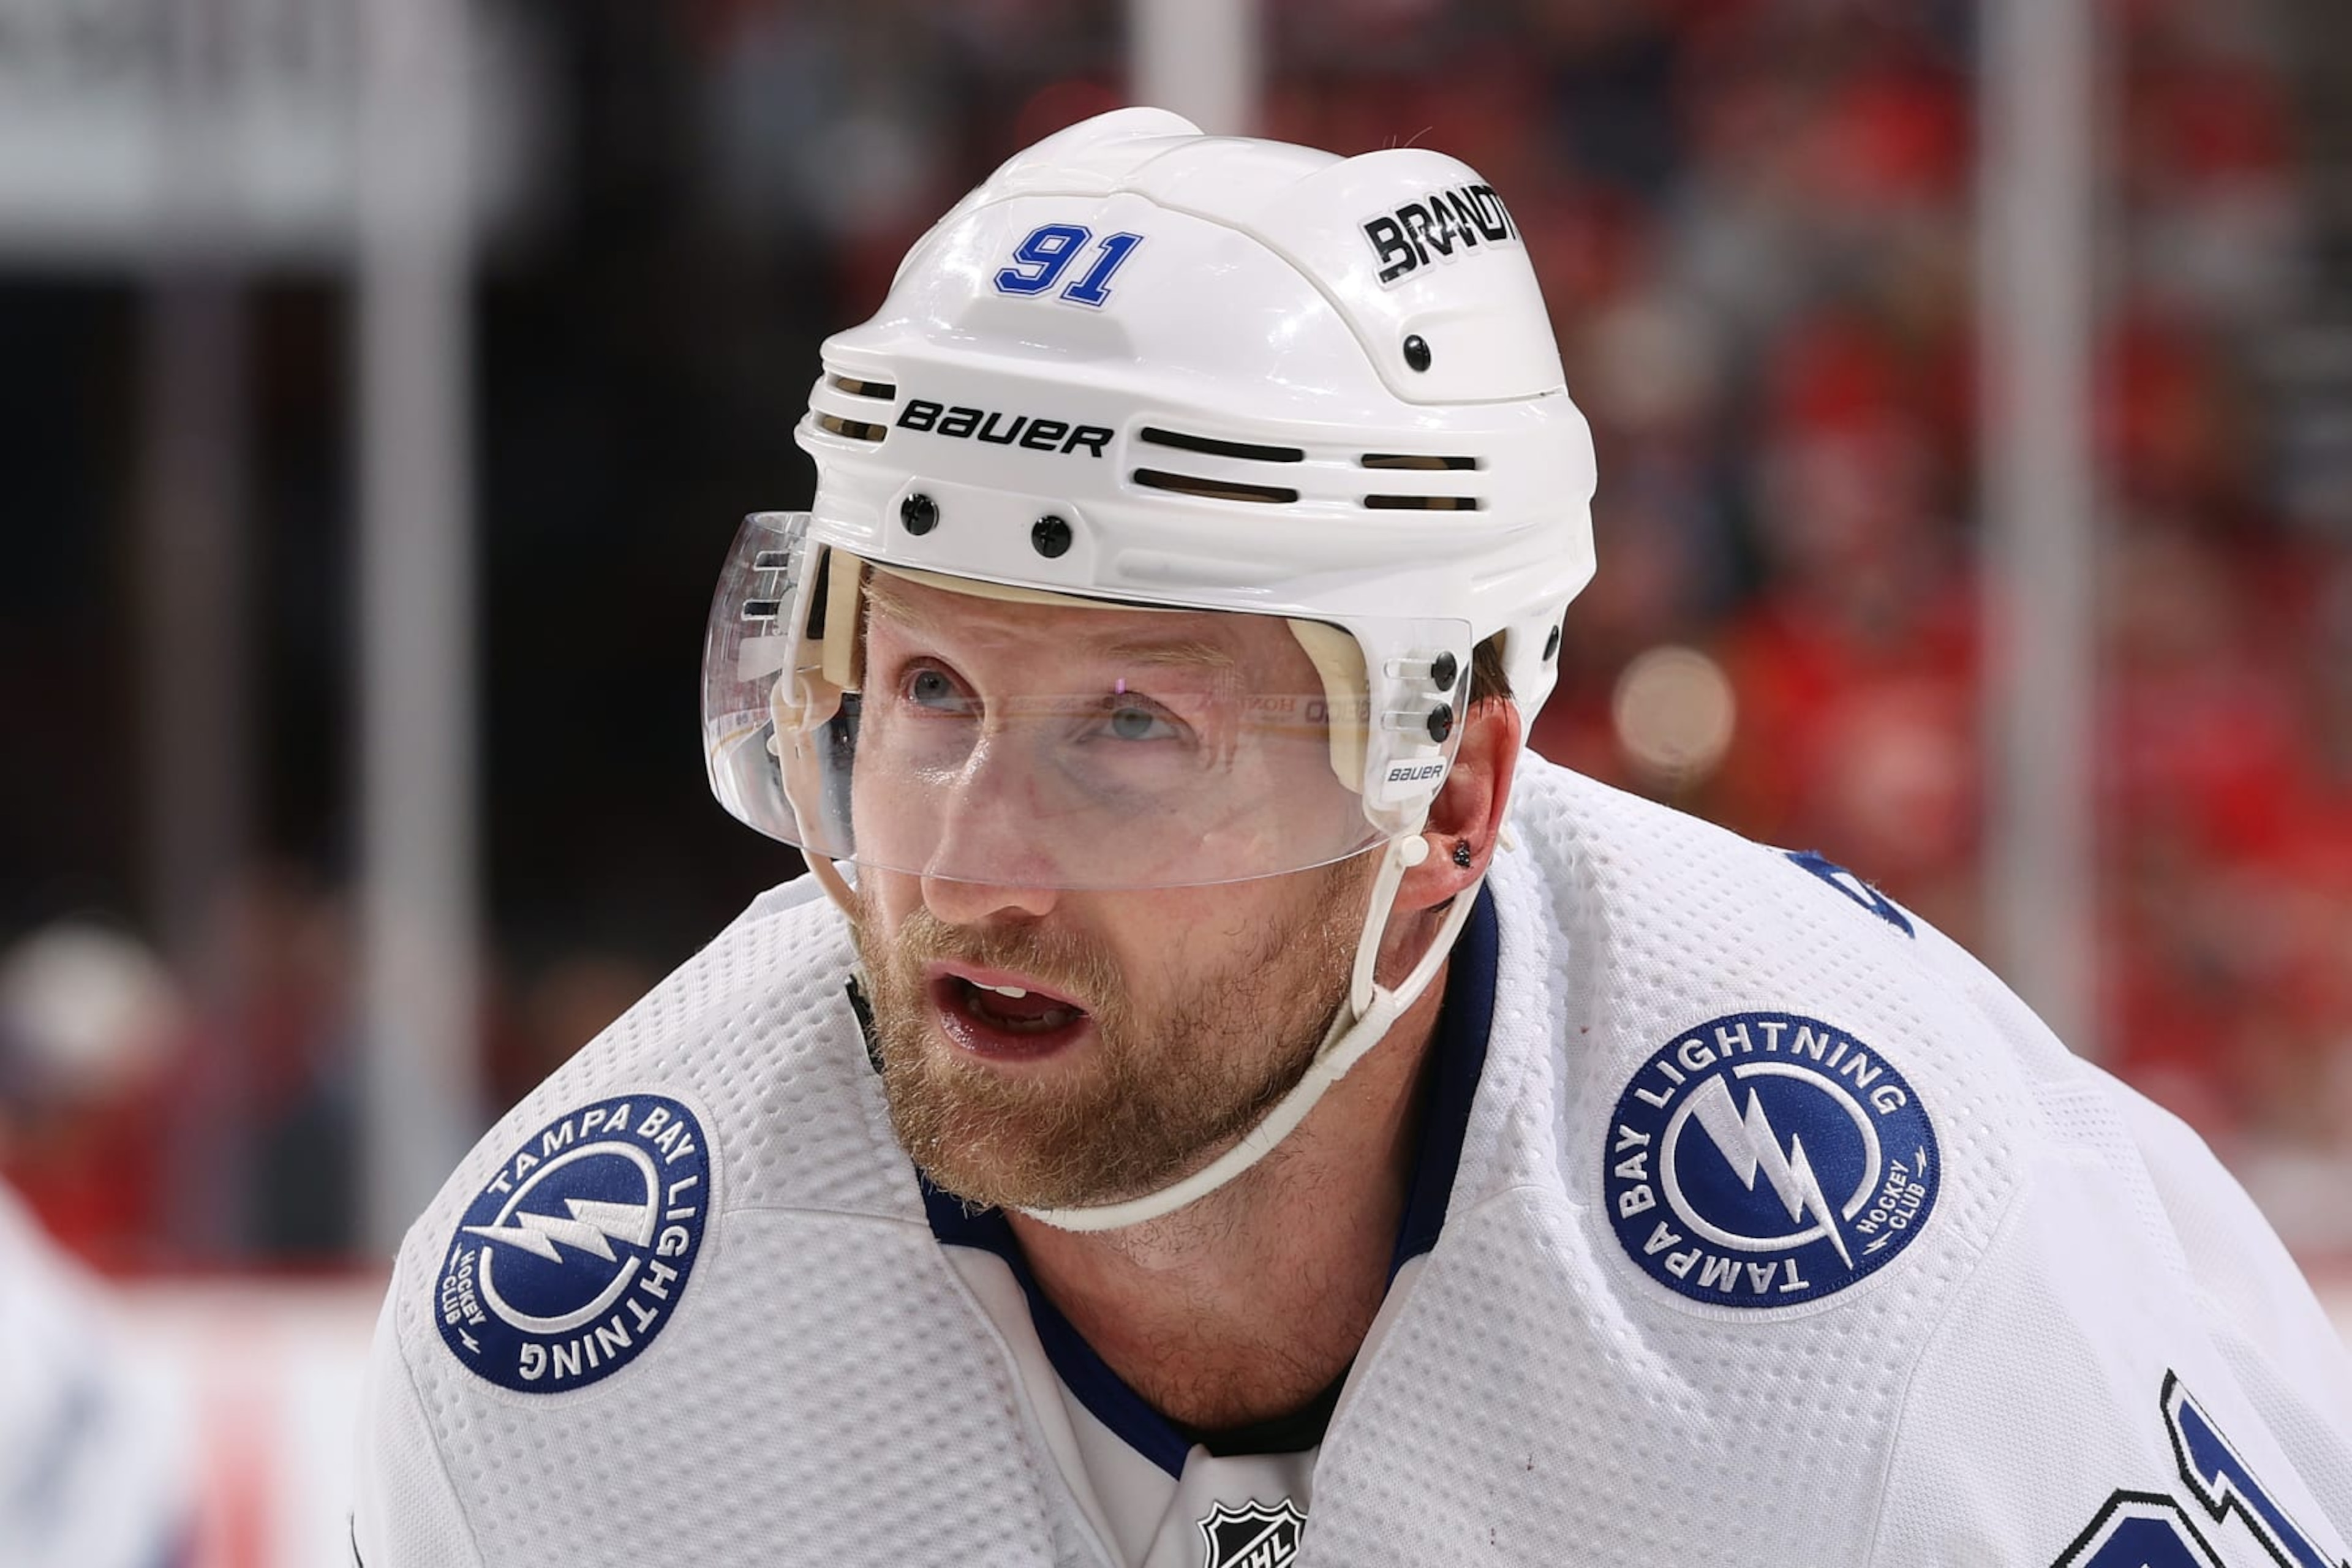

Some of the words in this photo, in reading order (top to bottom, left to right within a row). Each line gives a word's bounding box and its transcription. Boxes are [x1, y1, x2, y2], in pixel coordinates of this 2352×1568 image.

[993, 223, 1144, 307] 91
[1635, 1022, 1907, 1115] LIGHTNING
[487, 1103, 631, 1195] TAMPA
[637, 1106, 695, 1165] BAY
[1615, 1125, 1656, 1219] BAY
[1856, 1159, 1910, 1234] HOCKEY
[1890, 1183, 1926, 1231] CLUB
[458, 1250, 486, 1325] HOCKEY
[519, 1175, 698, 1381] LIGHTNING
[1643, 1221, 1809, 1294] TAMPA
[442, 1275, 461, 1325] CLUB
[1242, 1532, 1291, 1568] HL
